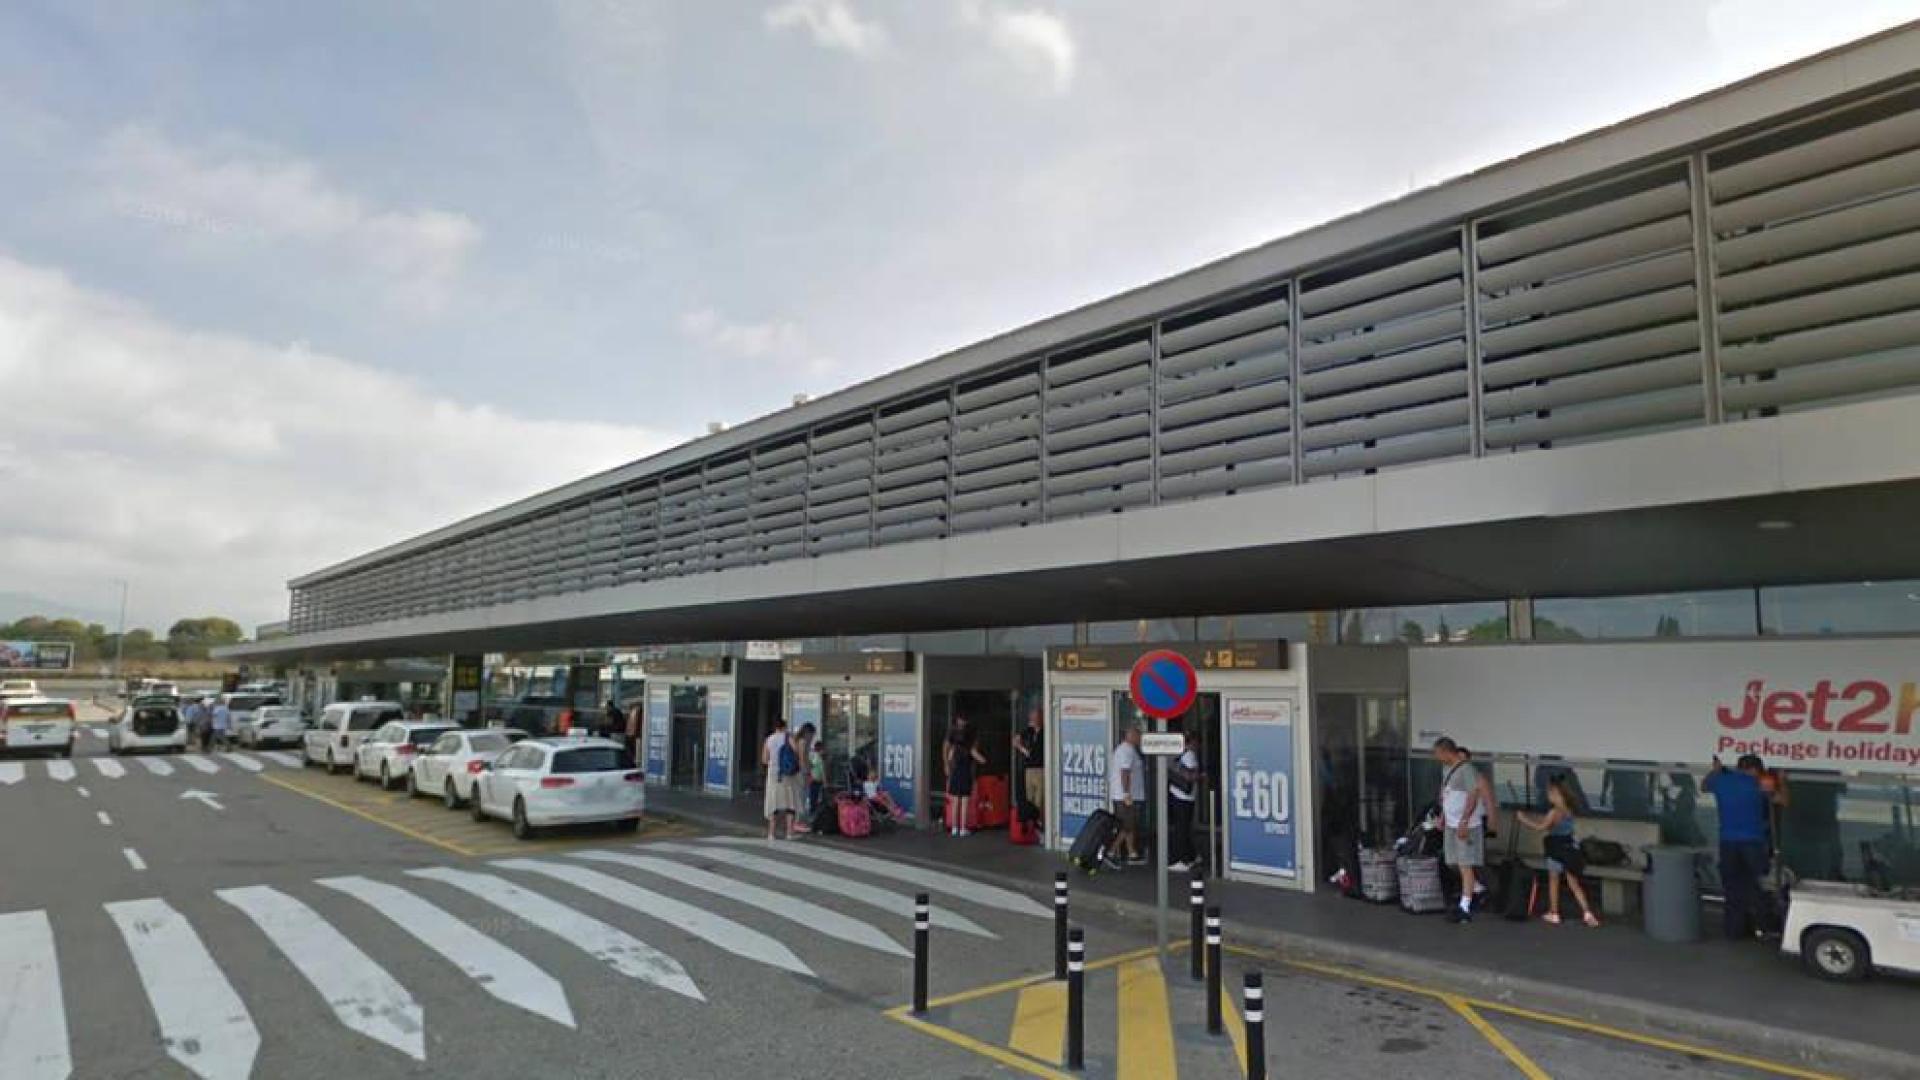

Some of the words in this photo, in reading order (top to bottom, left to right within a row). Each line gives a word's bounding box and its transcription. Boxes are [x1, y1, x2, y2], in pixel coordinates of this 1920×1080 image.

[884, 744, 913, 778] £60
[1718, 736, 1819, 760] Package
[1233, 769, 1289, 821] £60
